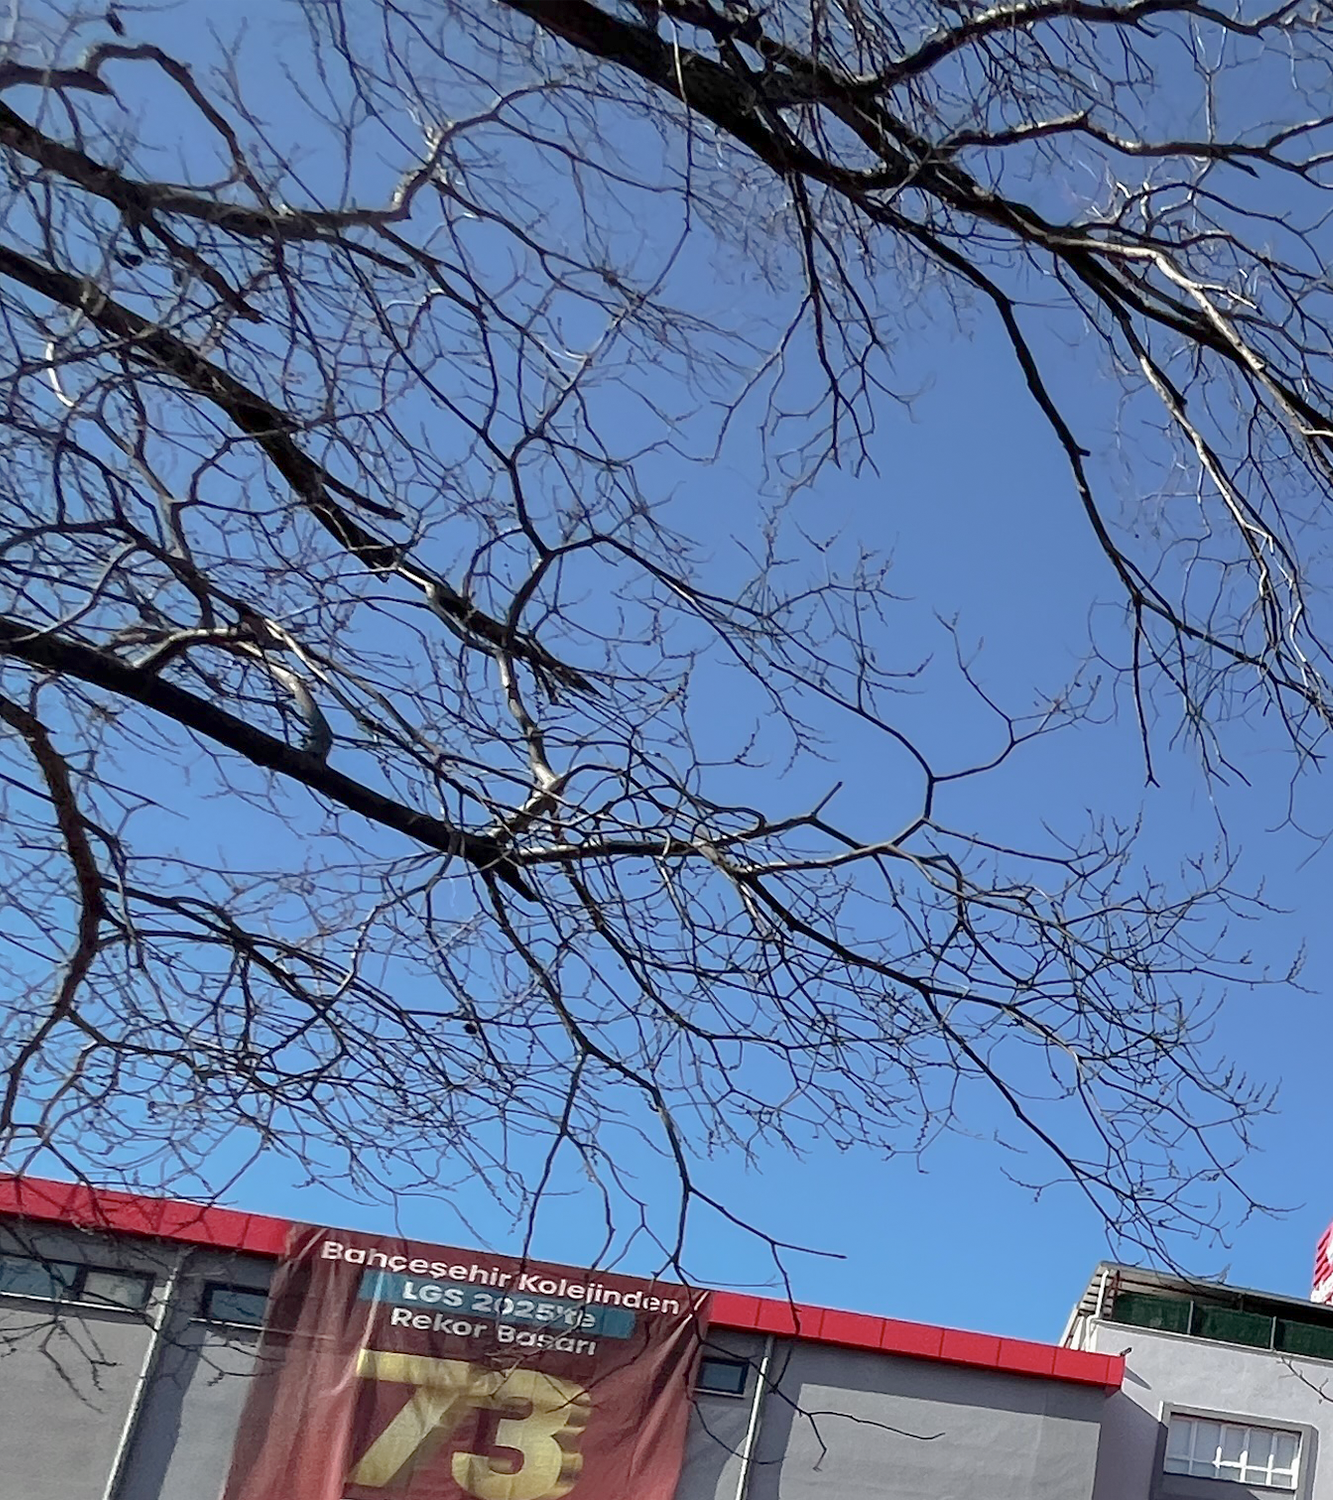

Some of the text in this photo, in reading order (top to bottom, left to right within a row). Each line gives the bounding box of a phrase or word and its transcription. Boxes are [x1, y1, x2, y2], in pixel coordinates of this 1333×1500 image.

[320, 1240, 680, 1316] Bahçeşehir Kolejinden
[402, 1280, 464, 1308] LGS
[390, 1306, 488, 1339] Rekor
